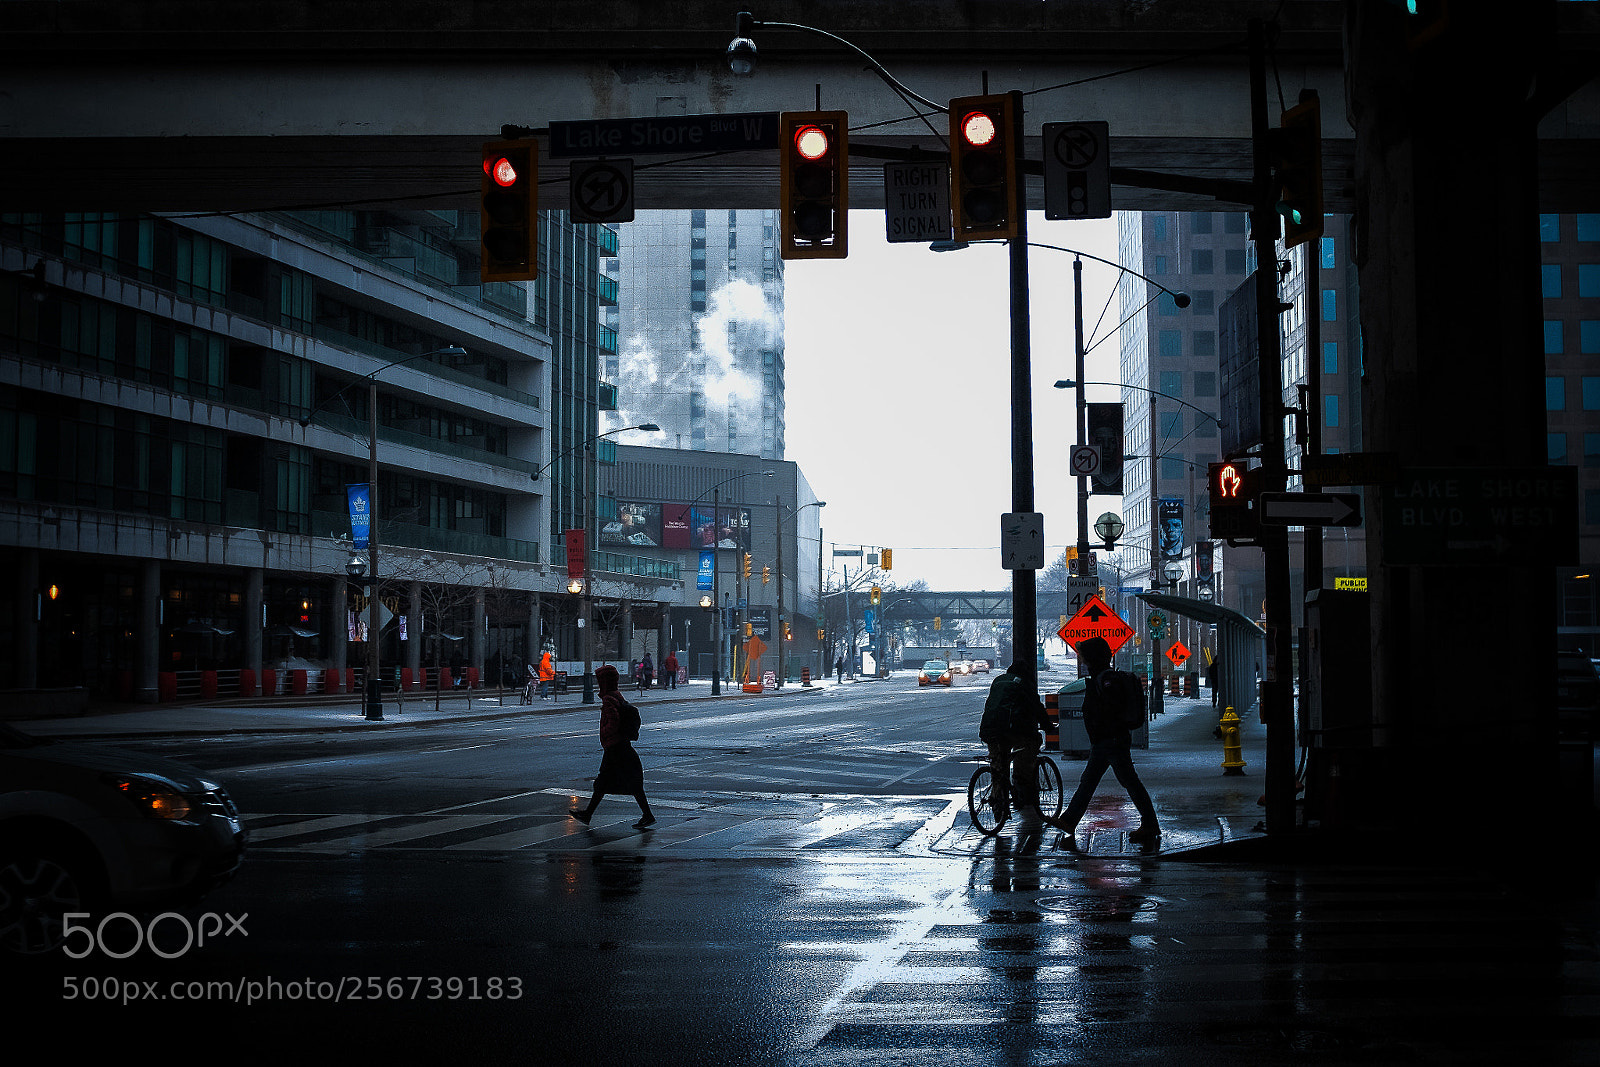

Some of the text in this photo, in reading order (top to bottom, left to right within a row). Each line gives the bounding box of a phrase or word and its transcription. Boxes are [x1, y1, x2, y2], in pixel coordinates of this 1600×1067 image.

[564, 117, 764, 148] Lake Shore Blvd W
[893, 167, 940, 187] RIGHT
[899, 192, 937, 210] TURN
[893, 215, 946, 235] SIGNAL
[1393, 479, 1569, 500] LAKE SHORE
[1489, 506, 1557, 527] WEST
[1070, 580, 1097, 588] MAXIMUM
[1064, 628, 1127, 639] CONSTRUCTION
